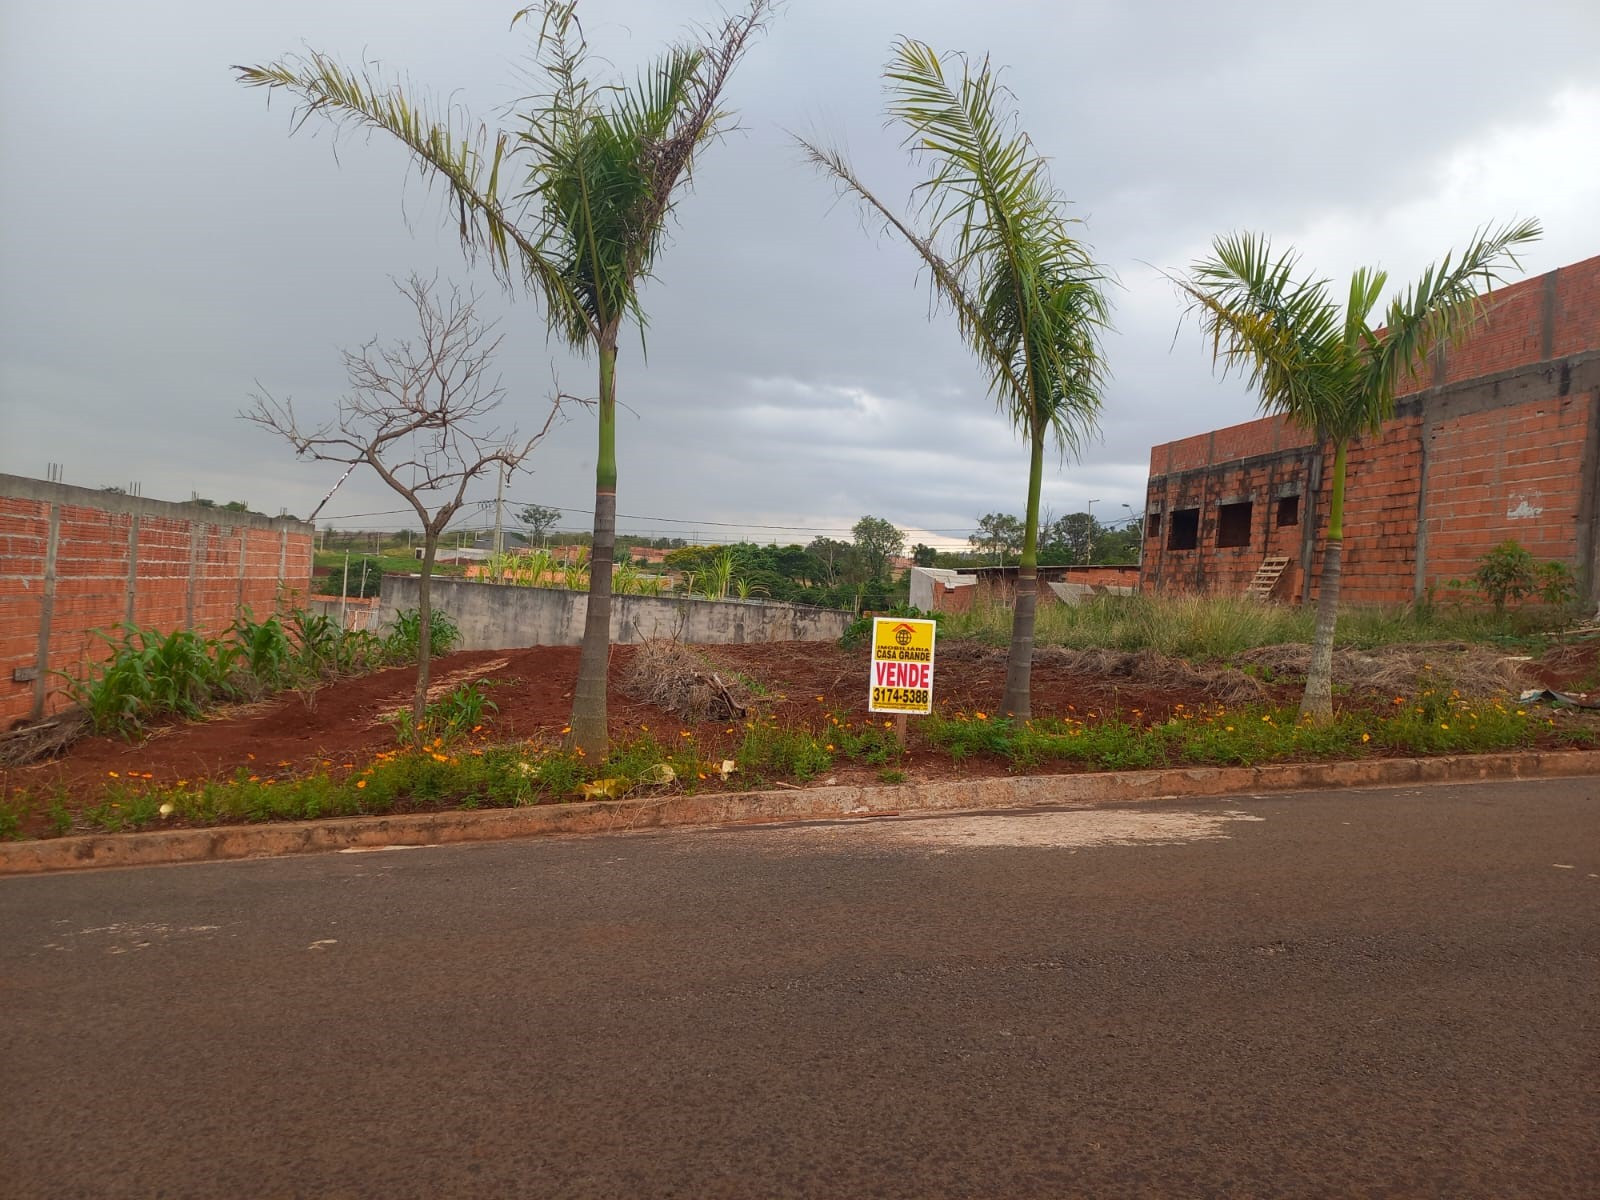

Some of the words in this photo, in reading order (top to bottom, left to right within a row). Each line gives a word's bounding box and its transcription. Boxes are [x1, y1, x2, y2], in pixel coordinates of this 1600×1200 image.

[876, 650, 897, 660] CASA
[898, 651, 931, 661] GRANDE
[876, 662, 930, 688] VENDE
[873, 688, 928, 704] 3174-5388
